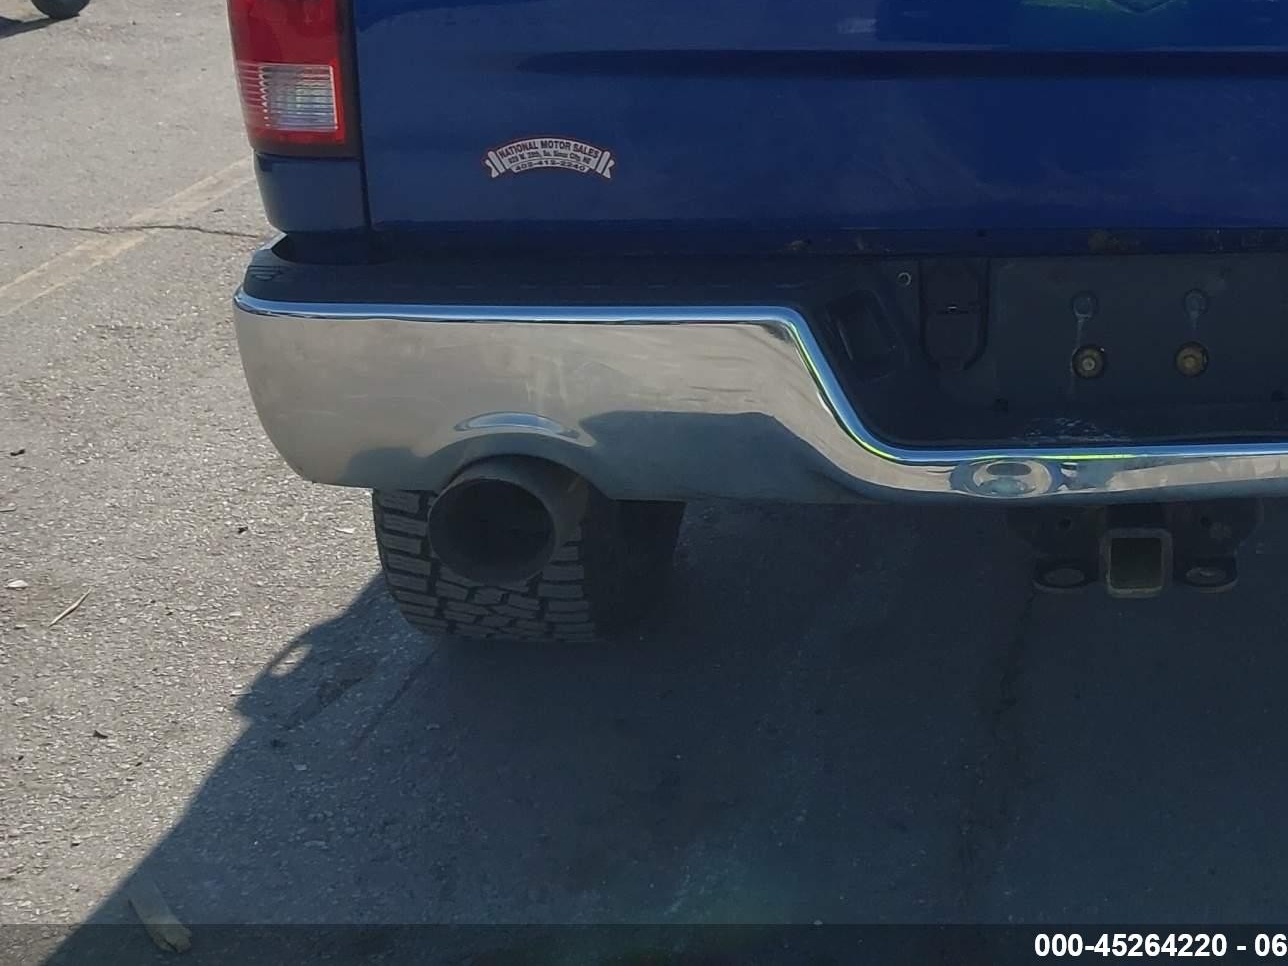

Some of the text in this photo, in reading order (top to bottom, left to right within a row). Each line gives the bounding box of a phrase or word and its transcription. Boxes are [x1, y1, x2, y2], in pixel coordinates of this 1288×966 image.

[498, 140, 600, 159] NATIONAL MOTOR SALES
